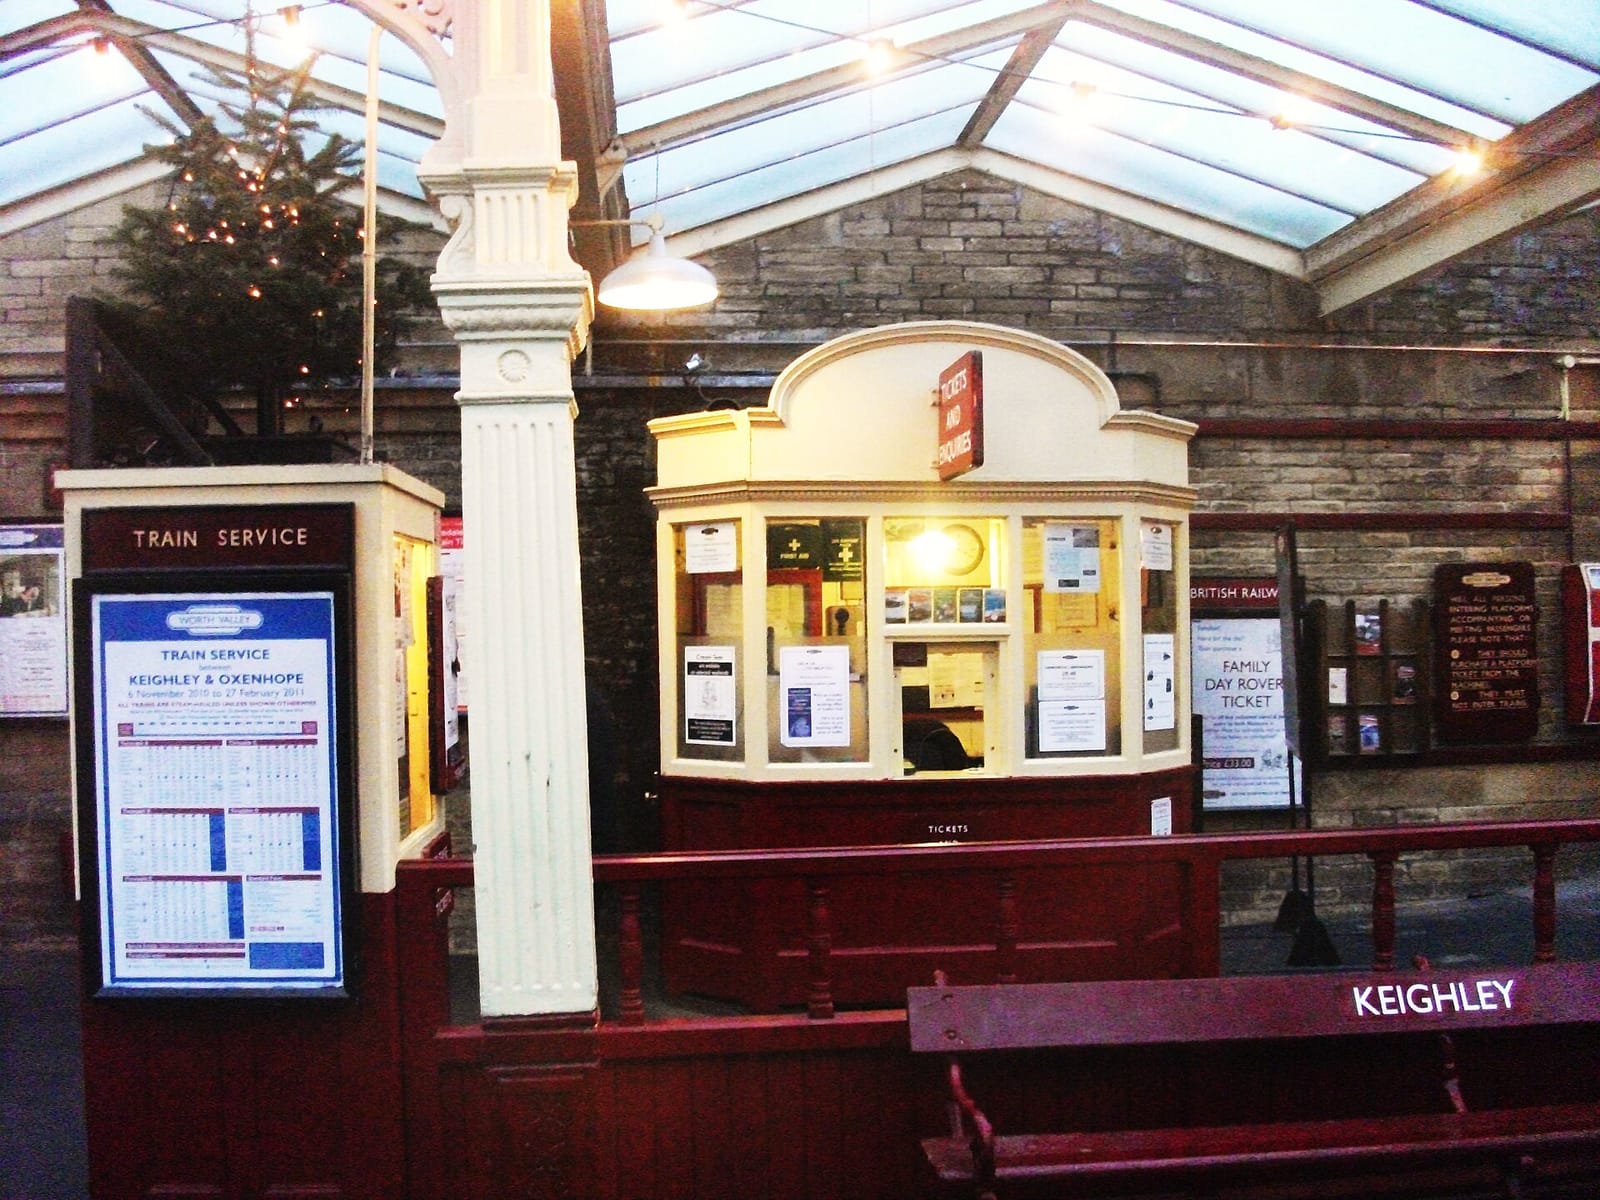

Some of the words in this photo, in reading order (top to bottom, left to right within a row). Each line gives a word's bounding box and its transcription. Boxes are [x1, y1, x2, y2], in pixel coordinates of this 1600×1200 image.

[941, 368, 967, 401] TICKETS
[946, 404, 961, 432] AND
[939, 430, 972, 465] ENQUIRIES
[133, 530, 198, 548] TRAIN
[218, 528, 308, 546] SERVICE
[1190, 587, 1237, 599] BRITISH
[178, 615, 214, 625] WORTH
[219, 615, 251, 624] VALLEY
[161, 650, 206, 661] TRAIN
[210, 649, 270, 660] SERVICE
[1223, 661, 1270, 673] FAMILY
[129, 674, 201, 686] KEIGHLEY
[205, 674, 214, 685] &
[219, 673, 304, 685] OXENHOPE
[1205, 679, 1233, 691] DAY
[1238, 678, 1284, 690] ROVER
[128, 691, 133, 699] 6
[137, 690, 184, 699] November
[188, 689, 210, 698] 2010
[212, 690, 222, 698] to
[226, 689, 236, 697] 27
[239, 689, 280, 700] February
[283, 688, 304, 697] 2011
[1221, 696, 1272, 708] TICKET
[928, 824, 968, 833] TICKETS
[1353, 979, 1514, 1016] KEIGHLEY
